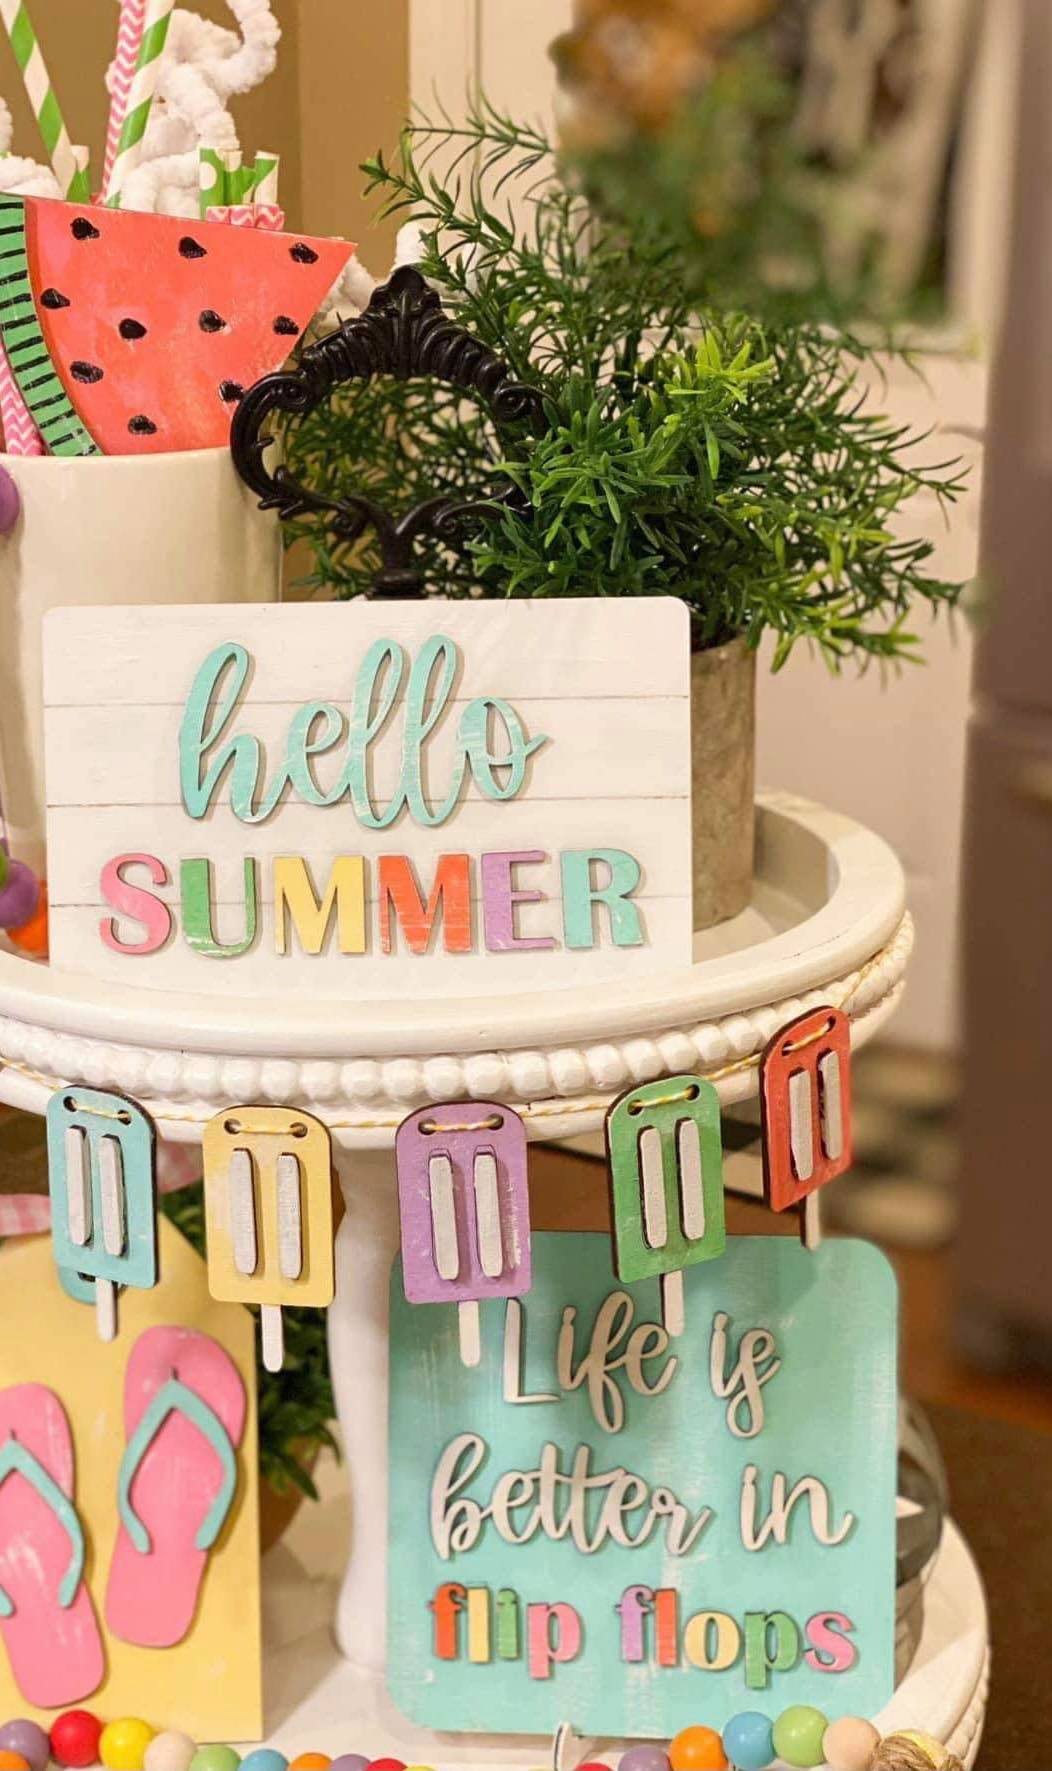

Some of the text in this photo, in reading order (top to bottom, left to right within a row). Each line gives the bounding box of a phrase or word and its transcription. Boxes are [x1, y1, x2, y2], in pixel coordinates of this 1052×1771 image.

[178, 635, 549, 828] hello
[100, 848, 646, 958] SUMMER
[503, 1290, 782, 1438] Life is
[430, 1432, 854, 1560] better in
[428, 1582, 858, 1690] flip flops
